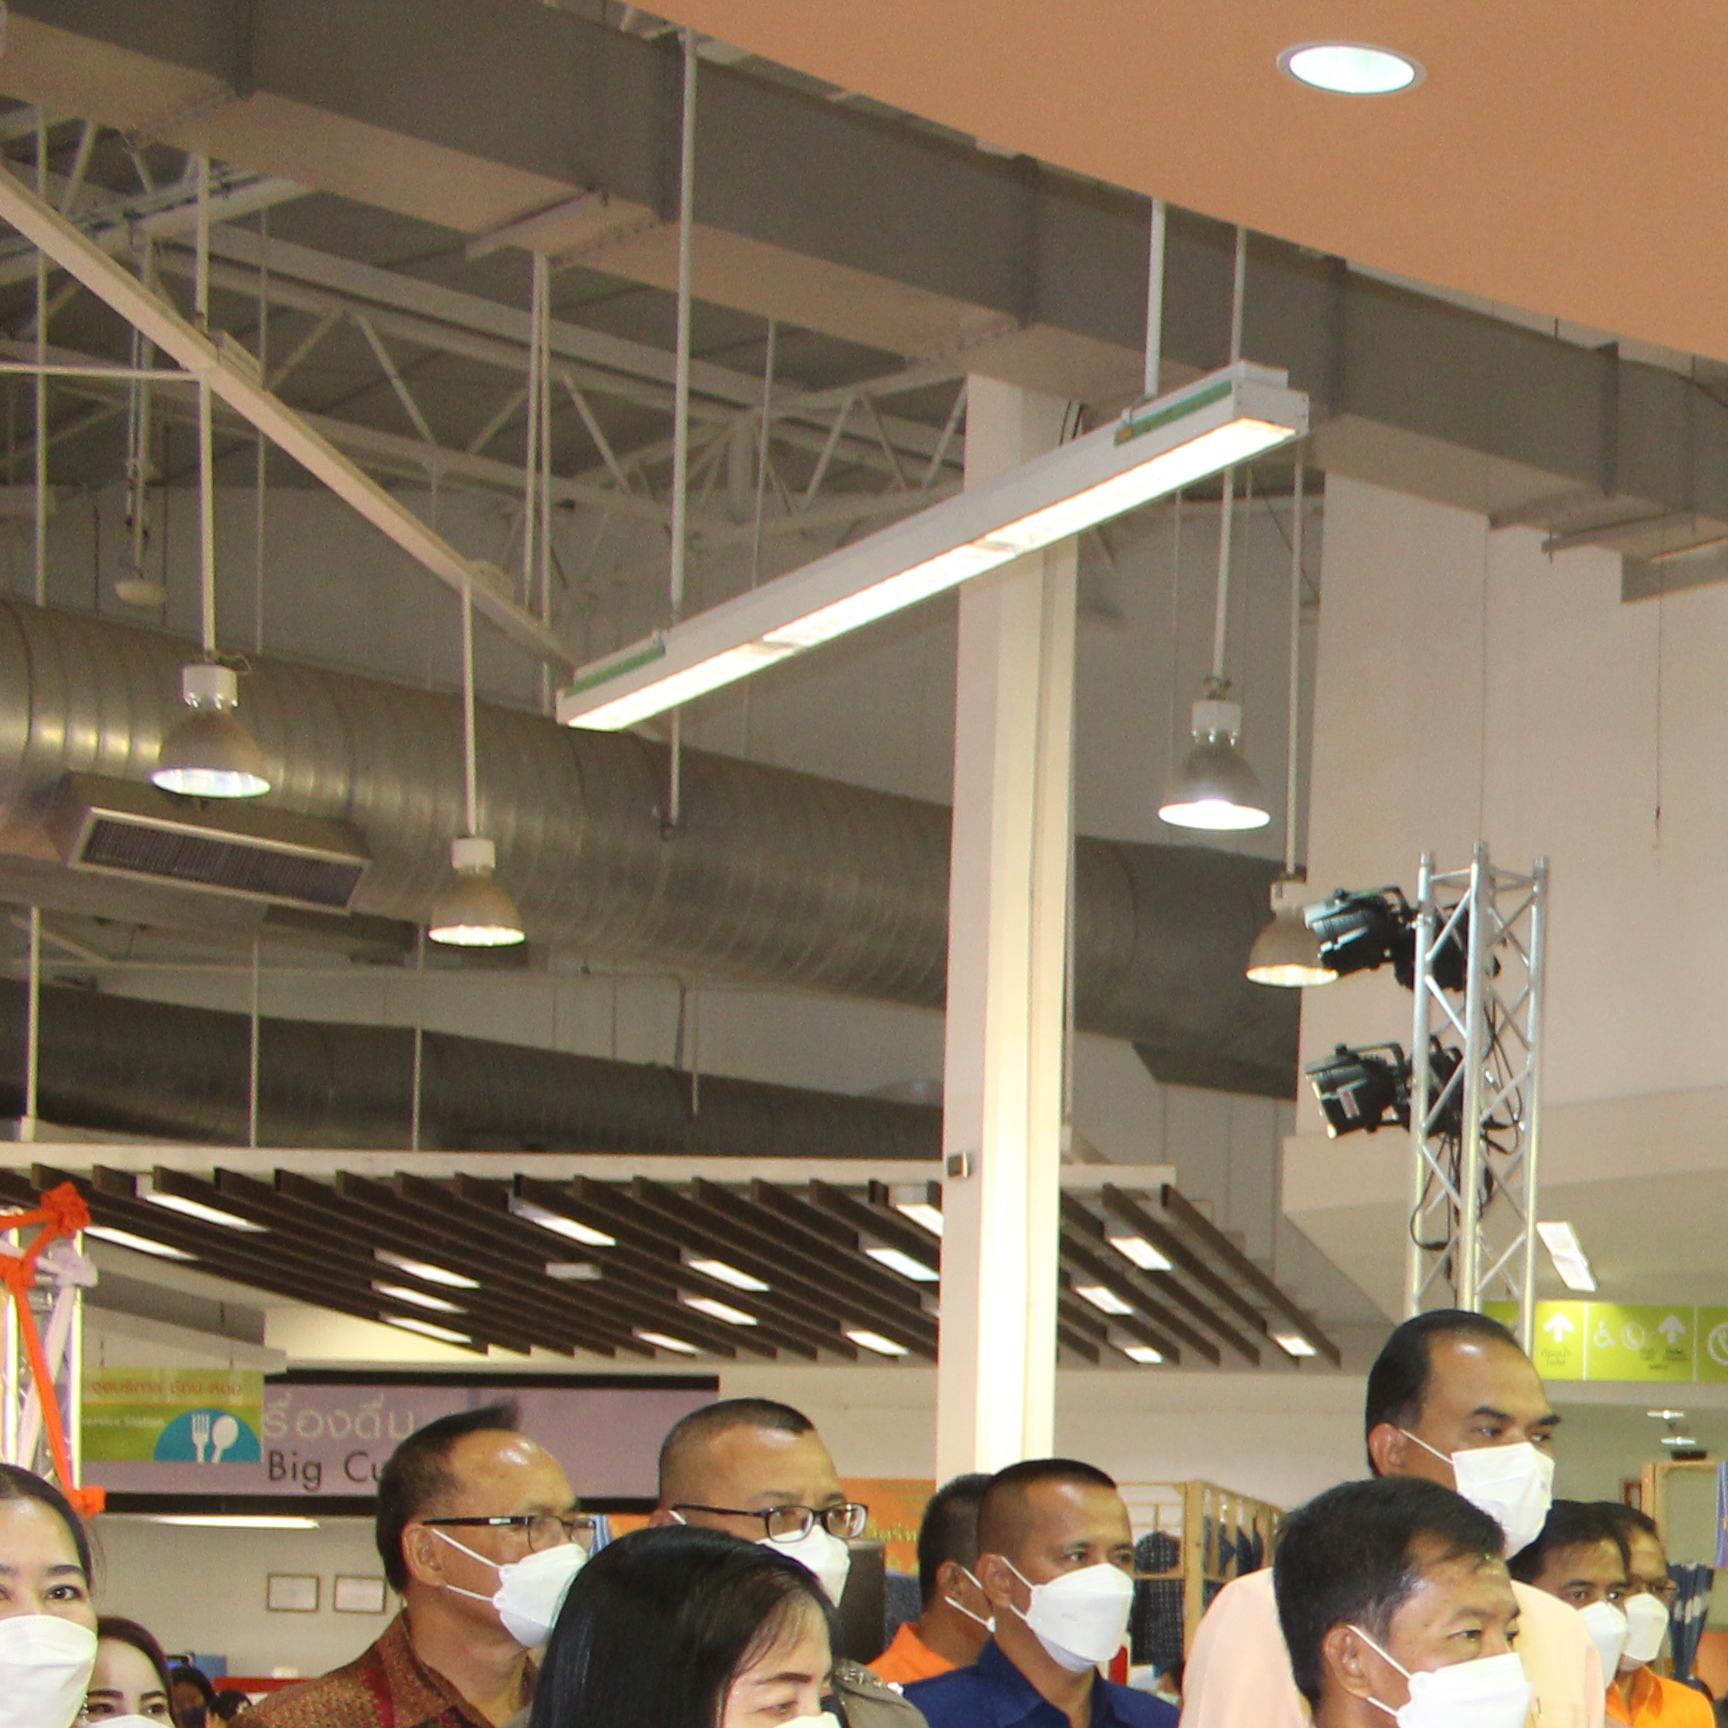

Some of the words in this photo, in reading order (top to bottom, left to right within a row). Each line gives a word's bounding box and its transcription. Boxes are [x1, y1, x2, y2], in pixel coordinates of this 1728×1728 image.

[263, 1391, 416, 1440] รื่องดื่ม
[268, 1450, 322, 1492] Big
